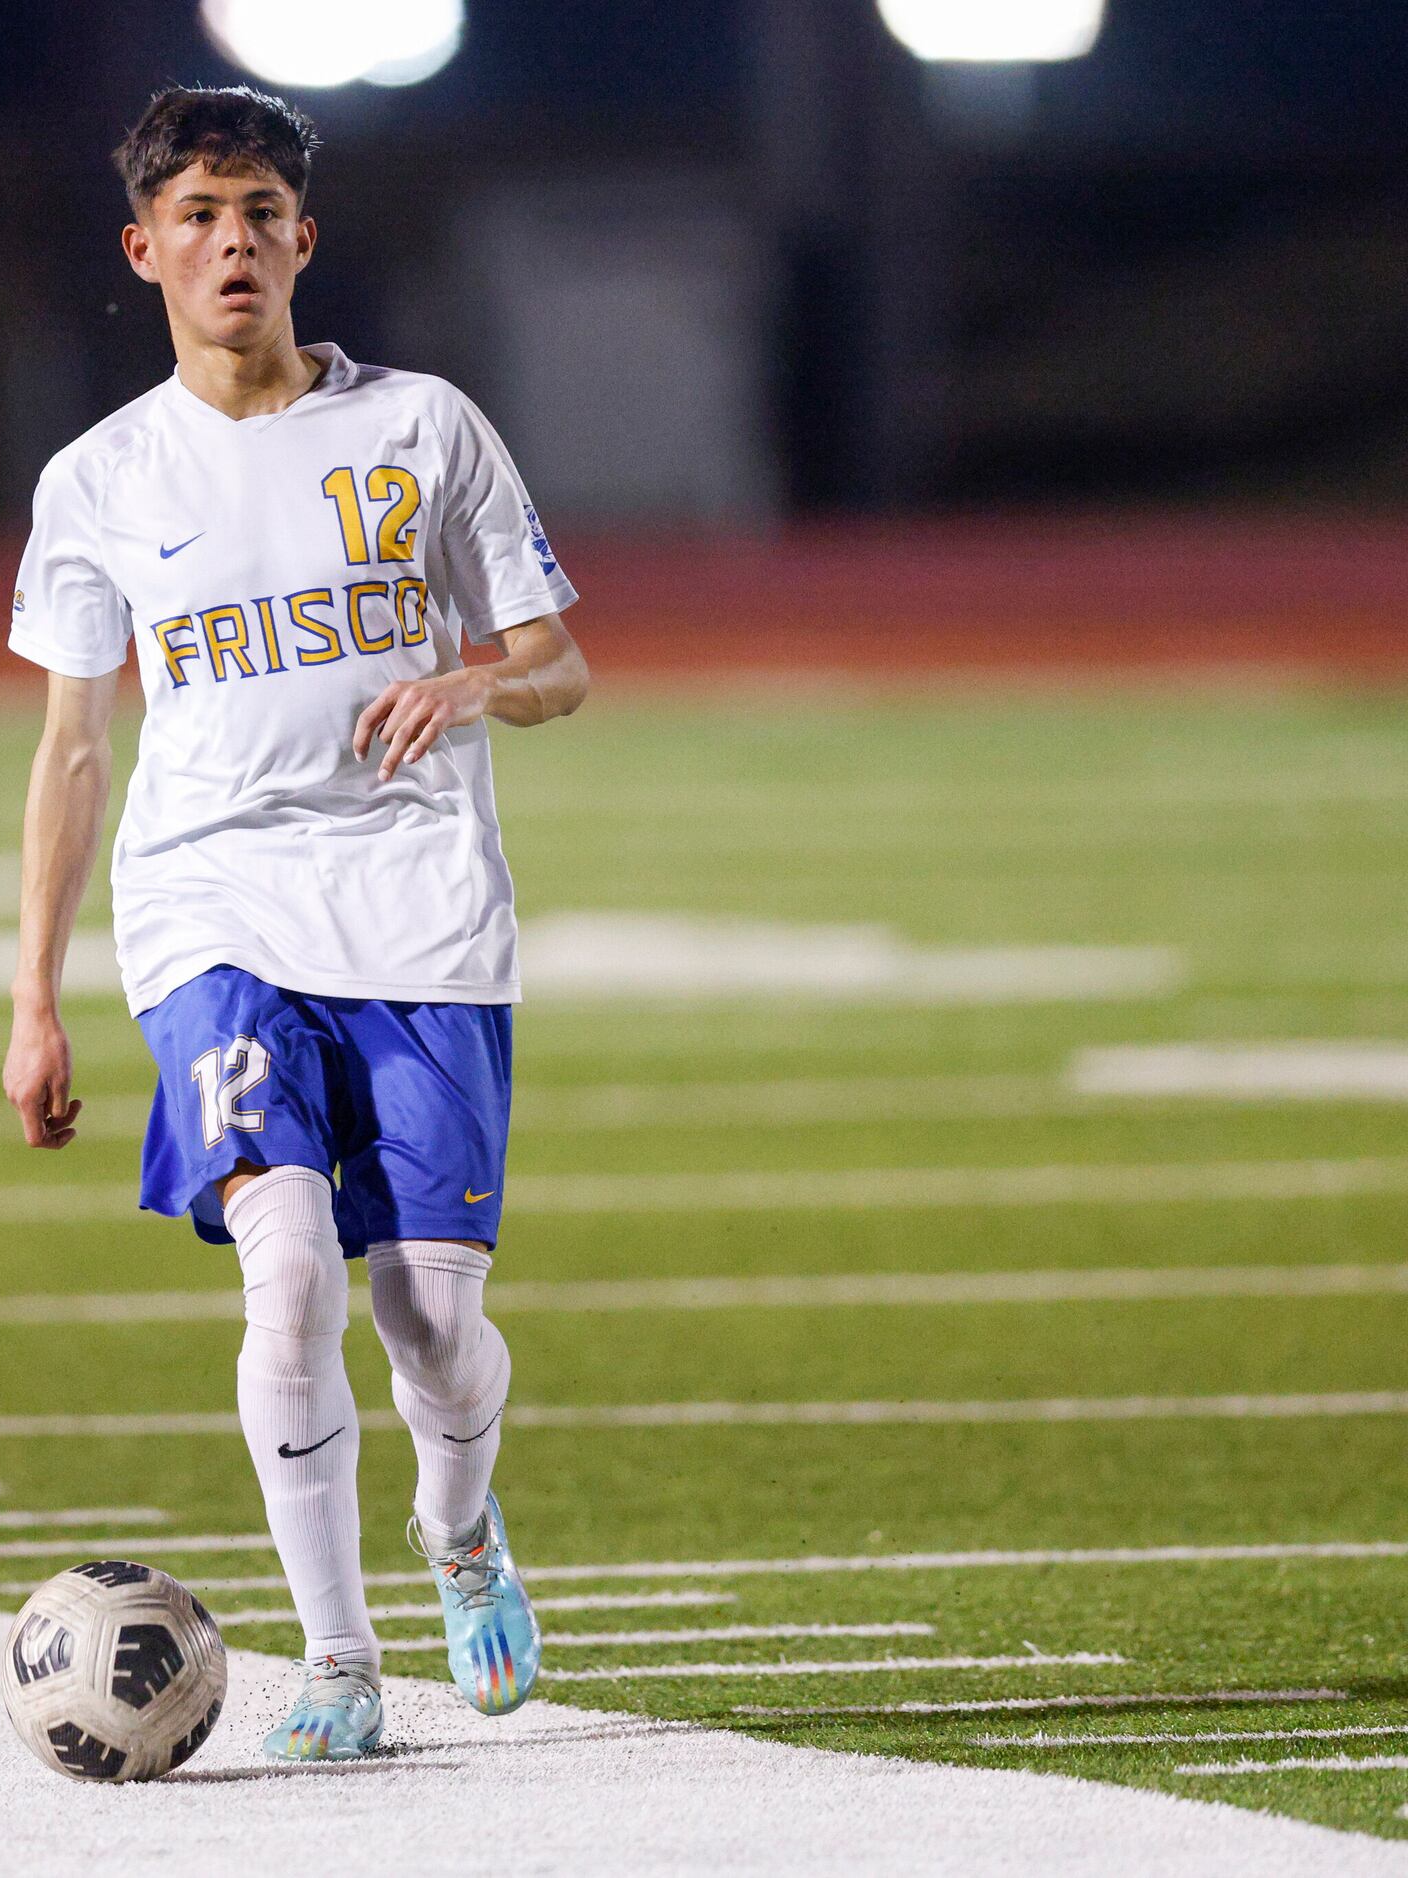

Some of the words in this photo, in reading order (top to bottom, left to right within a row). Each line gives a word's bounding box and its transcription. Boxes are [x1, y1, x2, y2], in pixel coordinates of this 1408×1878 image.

[321, 464, 421, 566] 12
[150, 576, 429, 690] FRISCO
[191, 1033, 271, 1150] 12
